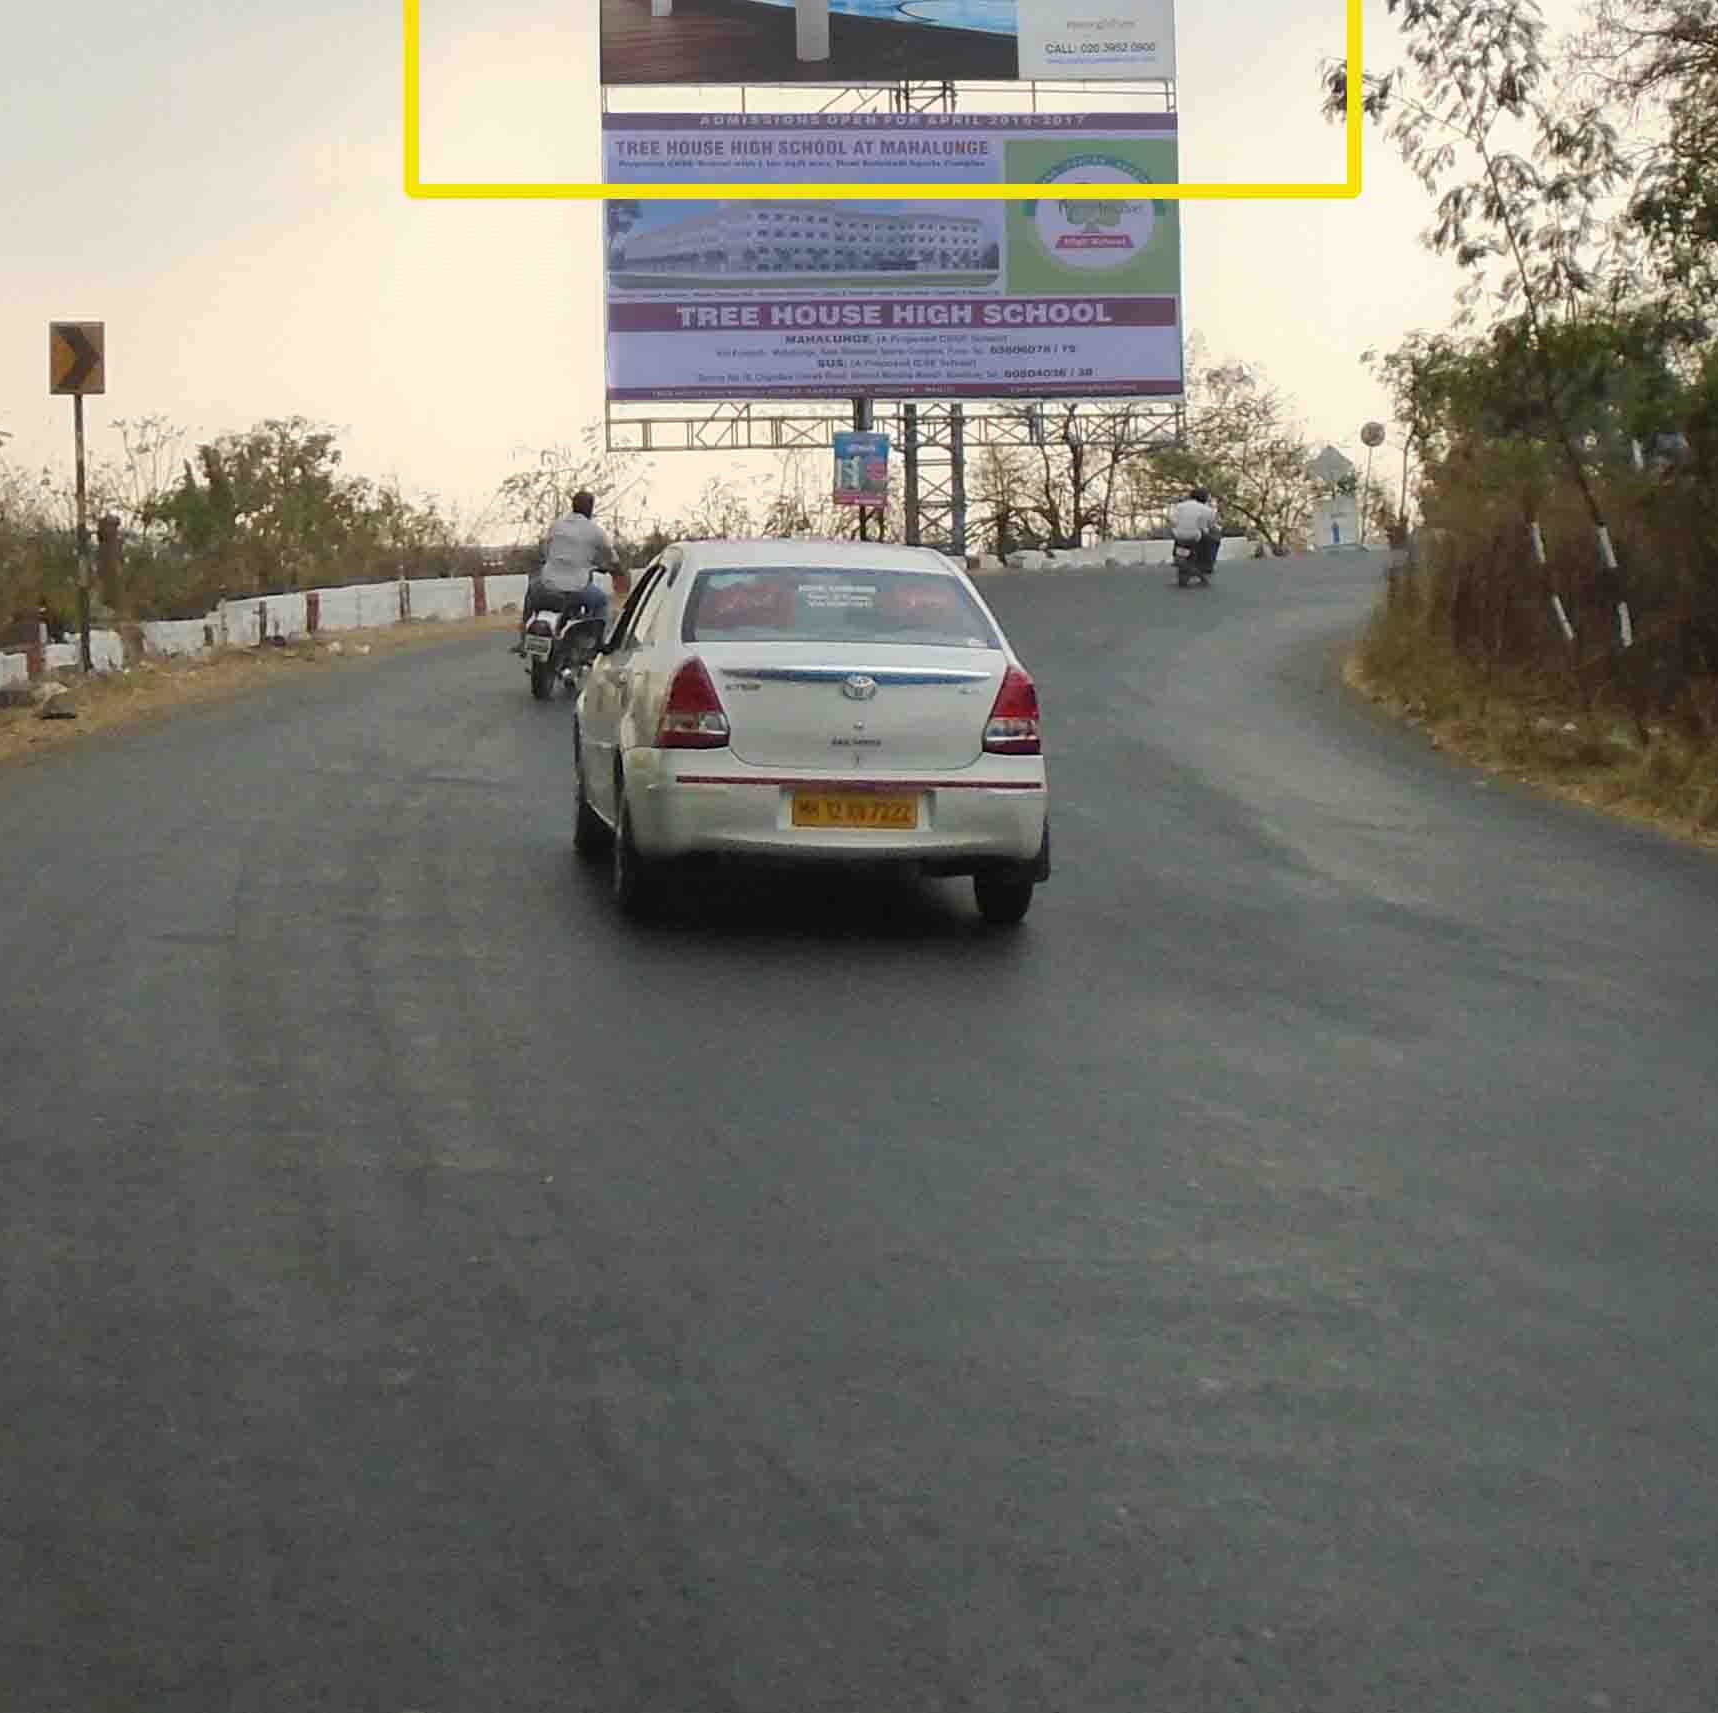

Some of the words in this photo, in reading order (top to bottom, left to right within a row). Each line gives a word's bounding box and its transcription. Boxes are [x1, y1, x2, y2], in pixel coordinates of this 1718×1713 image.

[699, 115, 820, 128] ADMISSIONS
[826, 114, 877, 126] OPEN
[884, 114, 924, 126] FOR
[927, 114, 980, 126] APRIL
[615, 140, 661, 156] TREE
[666, 140, 724, 156] HOUSE
[730, 140, 773, 156] HIGH
[777, 140, 849, 156] SCHOOL
[853, 140, 874, 156] AT
[879, 139, 989, 156] MAHALUNGE
[676, 304, 760, 328] TREE
[770, 304, 883, 327] HOUSE
[892, 302, 973, 325] HIGH
[983, 301, 1113, 325] SCHOOL
